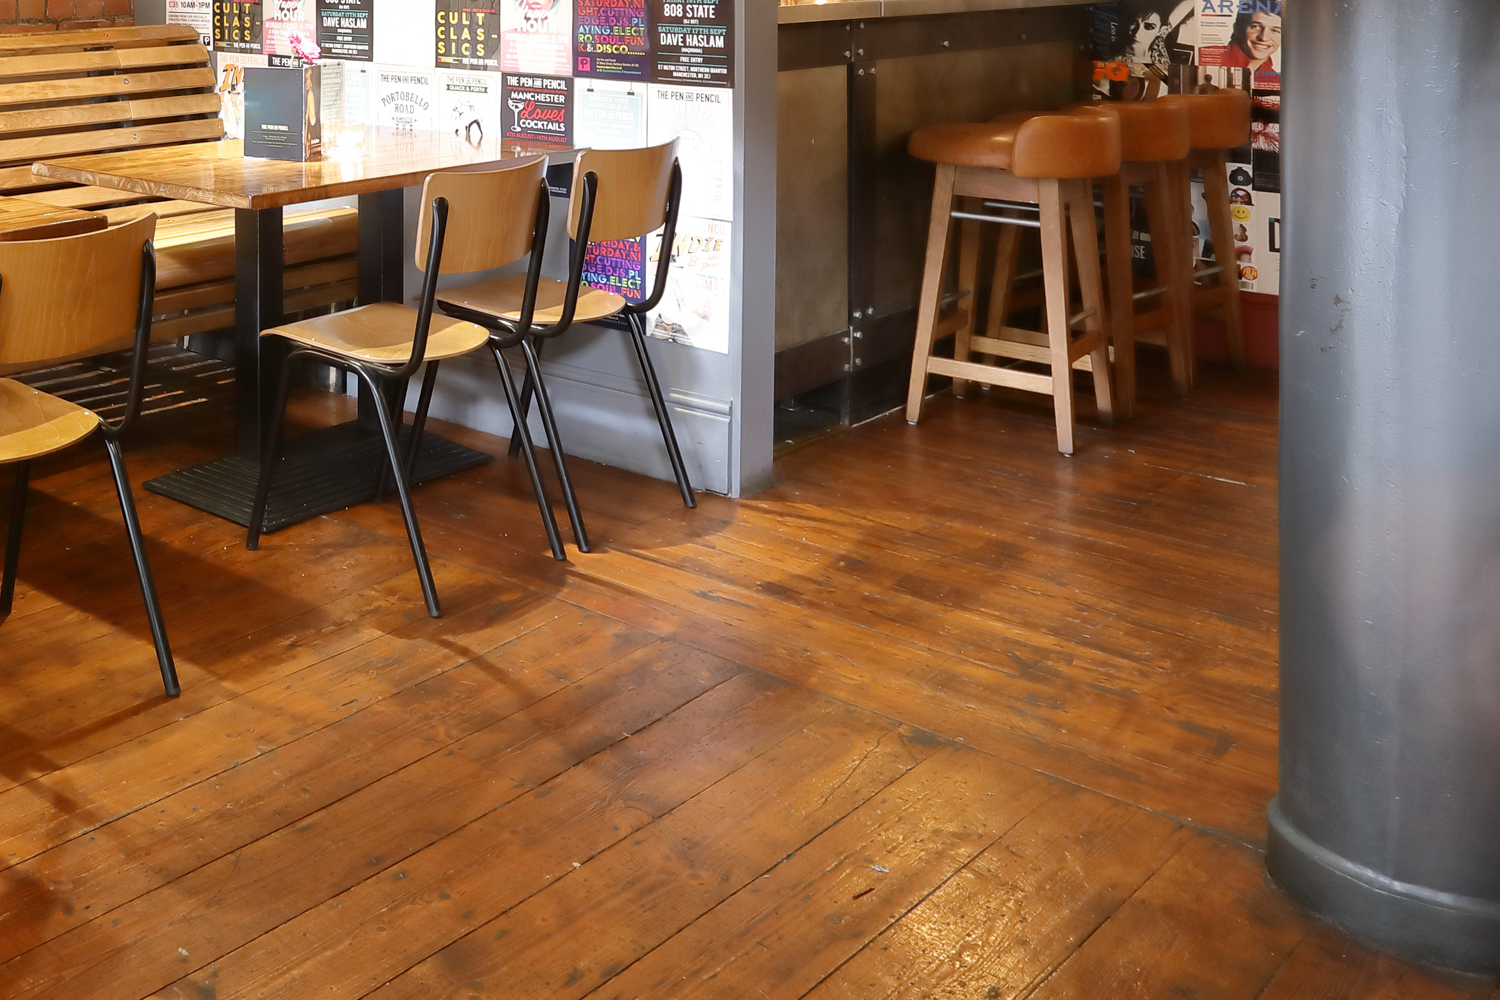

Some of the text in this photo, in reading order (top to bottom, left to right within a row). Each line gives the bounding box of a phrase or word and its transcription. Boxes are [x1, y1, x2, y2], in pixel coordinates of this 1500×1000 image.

[214, 2, 251, 14] CULT
[663, 3, 716, 18] 808 STATE
[273, 9, 305, 22] HOUR
[437, 11, 485, 26] CULT
[322, 16, 367, 29] DAVE HASLAM
[214, 29, 251, 41] SICS
[660, 33, 725, 48] DAVE HASLAM
[437, 41, 485, 57] SICS
[380, 73, 429, 86] THE PEN PENCIL
[506, 76, 519, 87] THE
[520, 77, 533, 87] PEN
[543, 79, 567, 90] PENCIL
[381, 91, 430, 111] PORTOBELLO
[510, 91, 565, 103] MANCHESTER
[657, 90, 669, 100] THE
[671, 91, 684, 101] PEN
[696, 93, 722, 104] PENCIL
[394, 103, 415, 114] ROAD
[520, 100, 566, 122] Loves
[520, 119, 566, 132] COCKTAILS
